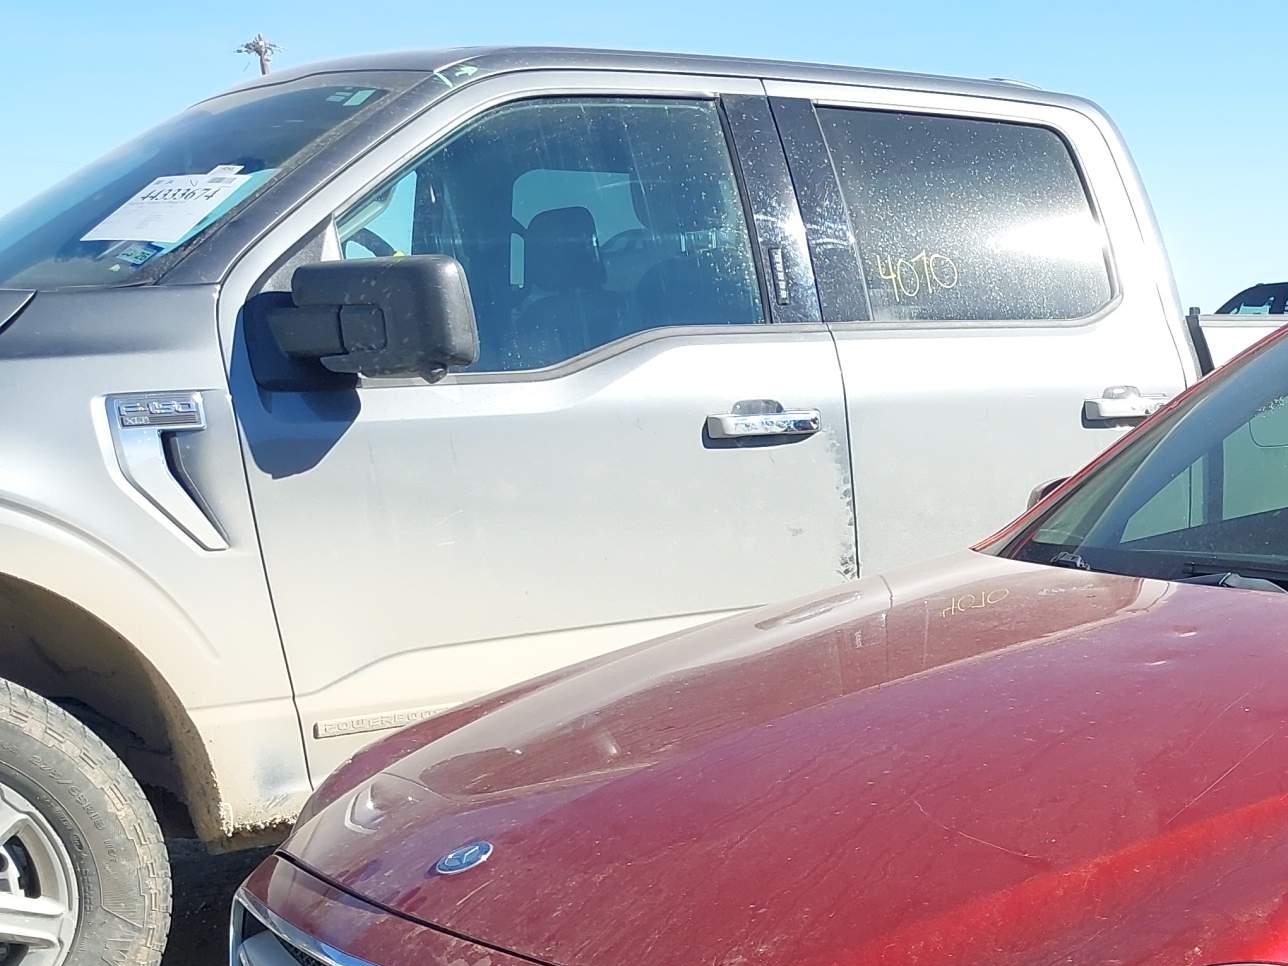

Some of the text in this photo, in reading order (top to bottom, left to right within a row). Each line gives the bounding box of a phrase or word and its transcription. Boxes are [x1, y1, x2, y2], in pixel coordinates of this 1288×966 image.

[139, 187, 222, 202] 44333674
[119, 400, 198, 416] F-150
[323, 707, 449, 732] POWERBOO
